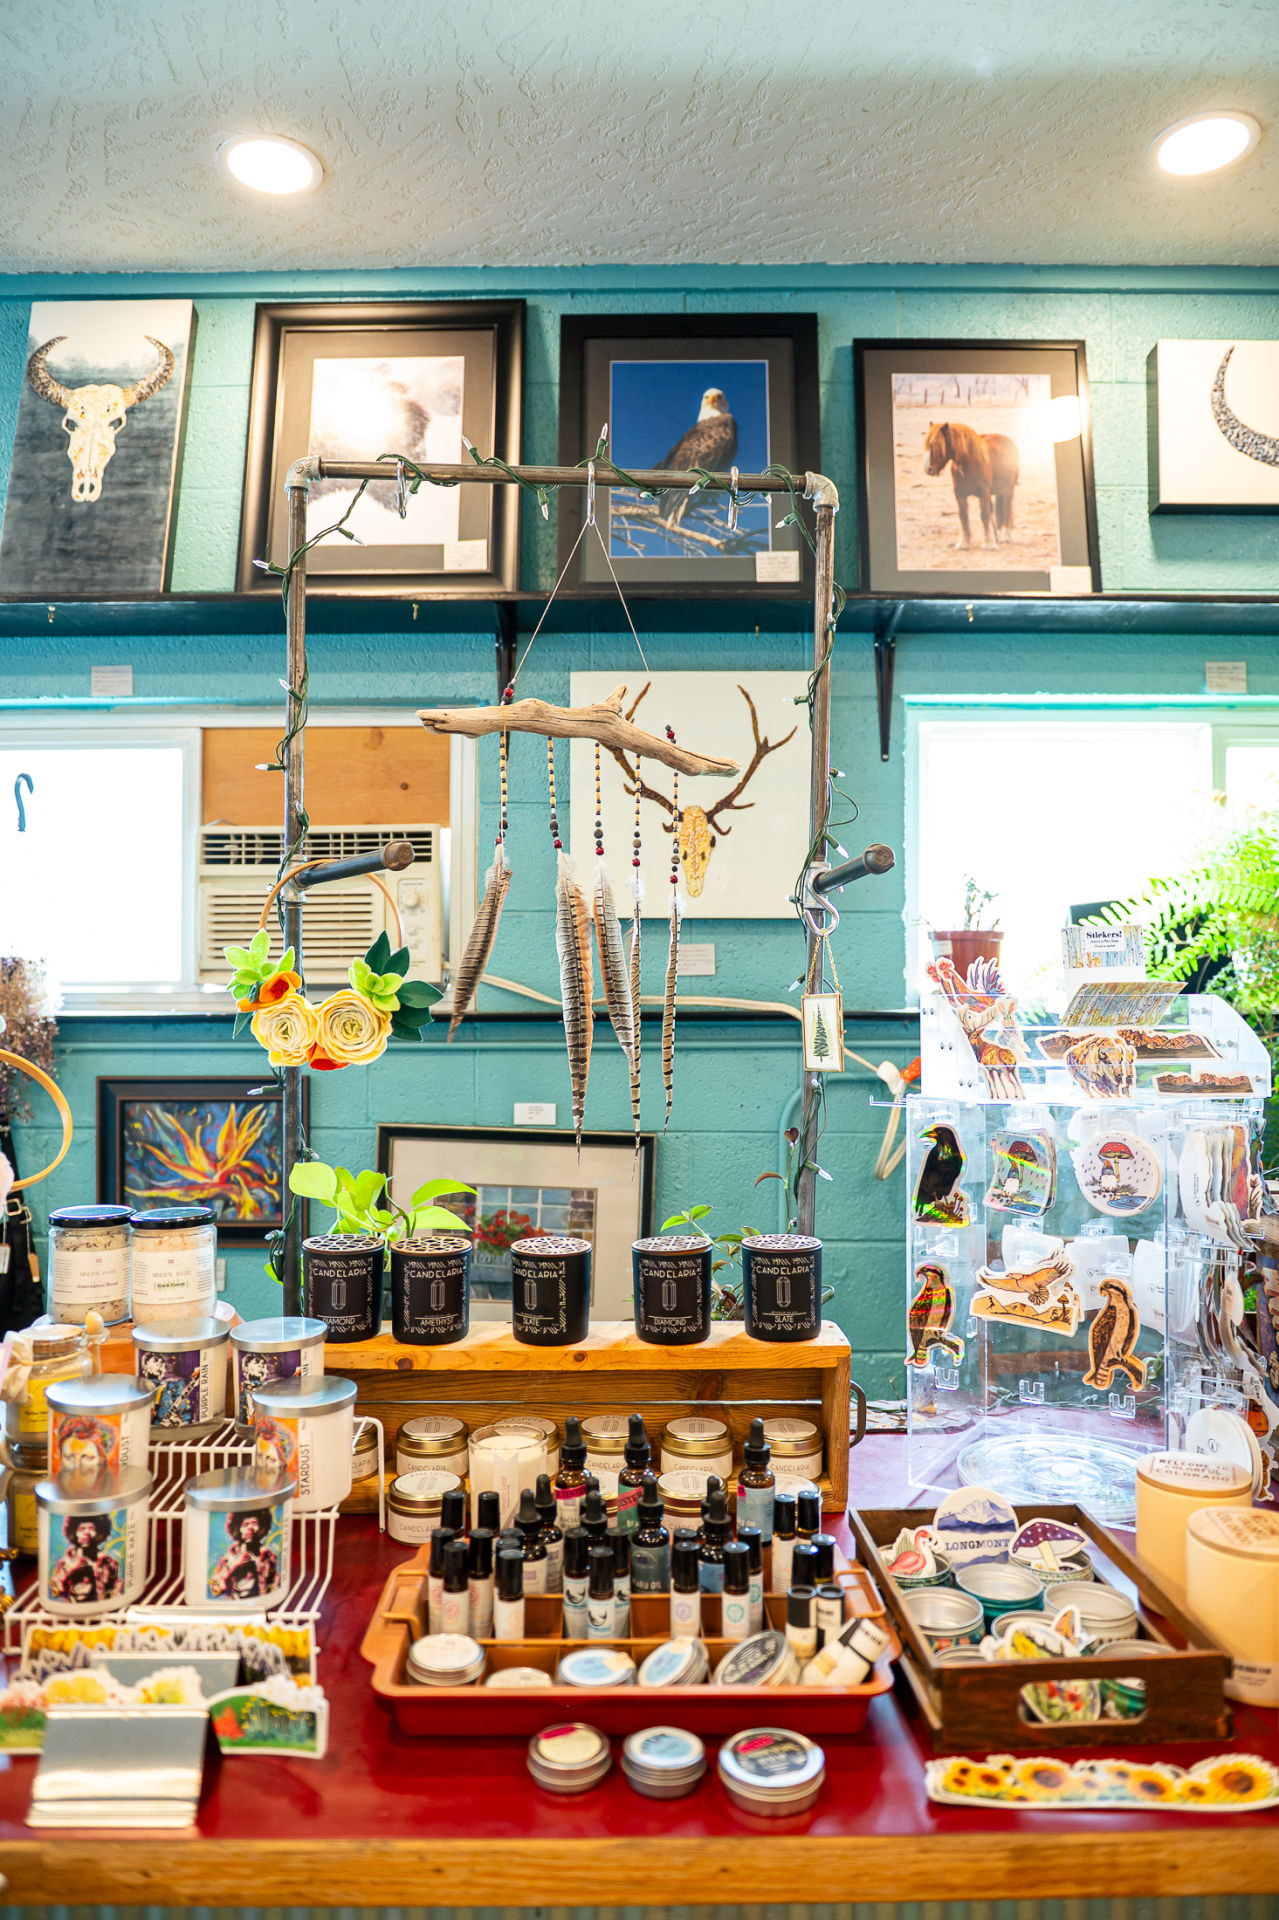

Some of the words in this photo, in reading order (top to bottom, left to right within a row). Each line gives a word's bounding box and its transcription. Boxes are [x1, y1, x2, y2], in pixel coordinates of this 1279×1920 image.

[1086, 931, 1122, 939] Stickers!
[313, 1268, 367, 1278] CANDELARIA
[409, 1268, 463, 1279] CANDELARIA
[512, 1267, 558, 1279] CANDELARIA
[643, 1268, 697, 1279] CANDELARIA
[756, 1265, 810, 1275] CANDELARIA
[323, 1317, 356, 1325] DIAMOND
[420, 1316, 454, 1326] AMETHYST
[523, 1316, 540, 1327] SLATE
[654, 1318, 686, 1327] DIAMOND
[775, 1315, 794, 1323] SLATE
[201, 1364, 209, 1385] RAIN
[301, 1363, 309, 1377] AIN
[201, 1387, 209, 1419] PURPLE
[352, 1458, 371, 1469] ELARIA
[587, 1461, 626, 1470] CANDELARIA
[1159, 1459, 1210, 1468] WELCOME
[301, 1444, 310, 1496] STARDUST
[1155, 1468, 1230, 1482] COLORADO
[1164, 1465, 1222, 1476] COLORFUL
[618, 1490, 644, 1507] ESTER
[128, 1523, 136, 1549] HAZE
[946, 1538, 1010, 1551] LONGMONT
[127, 1550, 135, 1589] PURPLE
